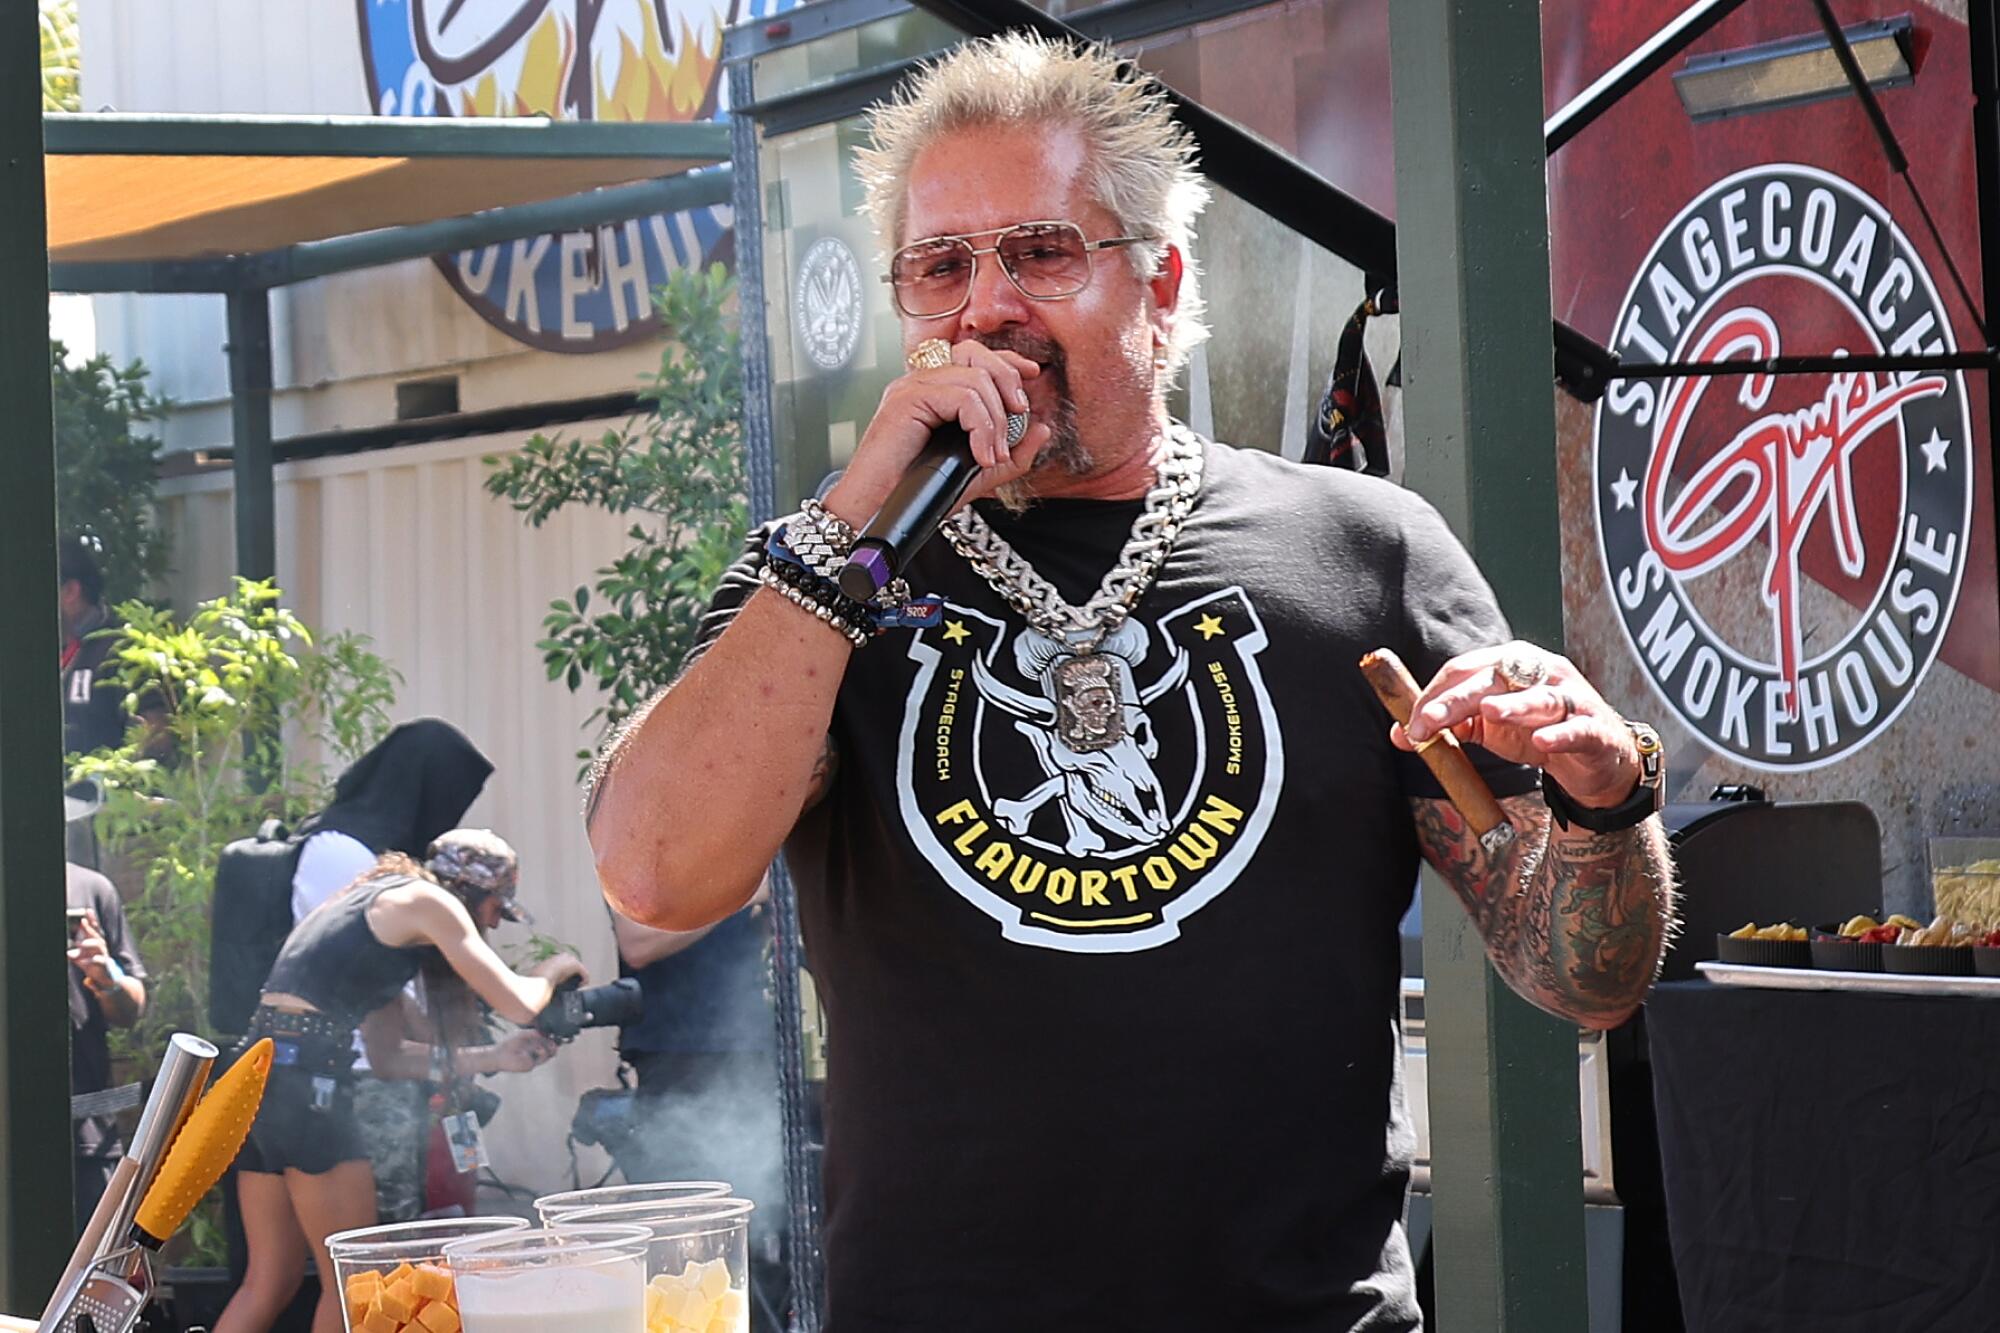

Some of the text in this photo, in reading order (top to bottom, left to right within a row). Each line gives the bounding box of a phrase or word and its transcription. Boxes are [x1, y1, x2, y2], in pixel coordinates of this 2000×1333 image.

[1608, 180, 1945, 426] STAGECOACH
[1618, 512, 1957, 757] SMOKEHOUSE
[935, 667, 965, 781] STAGECOACH
[1207, 660, 1243, 775] SMOKEHOUSE
[935, 794, 1245, 907] FLAVORTOWN
